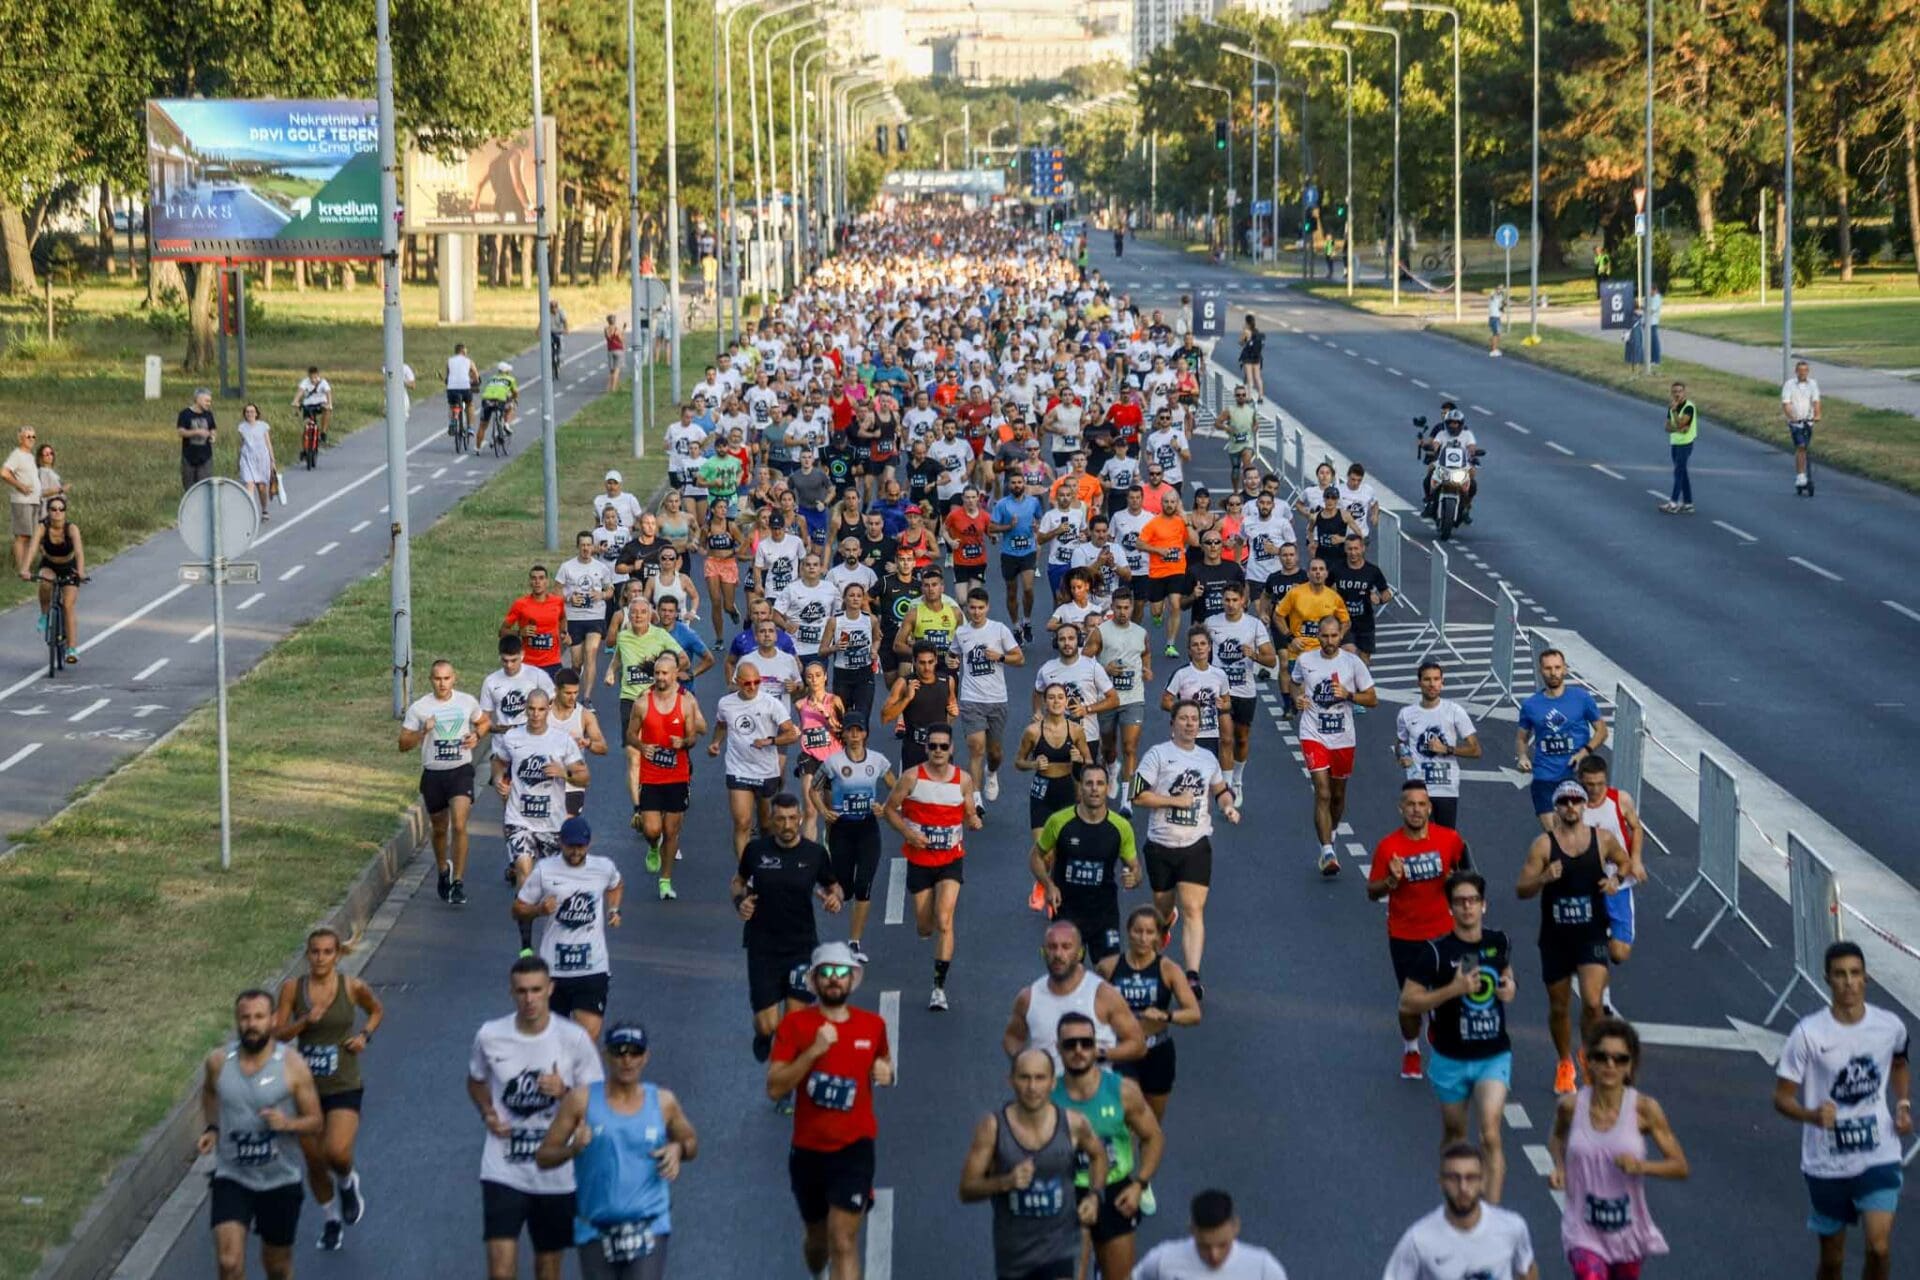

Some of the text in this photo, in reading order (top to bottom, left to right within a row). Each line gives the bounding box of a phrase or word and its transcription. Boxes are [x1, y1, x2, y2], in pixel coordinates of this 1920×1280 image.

[288, 112, 359, 126] Nekretnine
[286, 127, 326, 141] GOLF
[330, 127, 378, 141] TEREN
[319, 140, 350, 155] Crnoj
[353, 140, 378, 153] Gori
[318, 200, 378, 216] kredium
[1204, 301, 1215, 319] 6
[1611, 294, 1623, 312] 6
[569, 895, 592, 913] 10K
